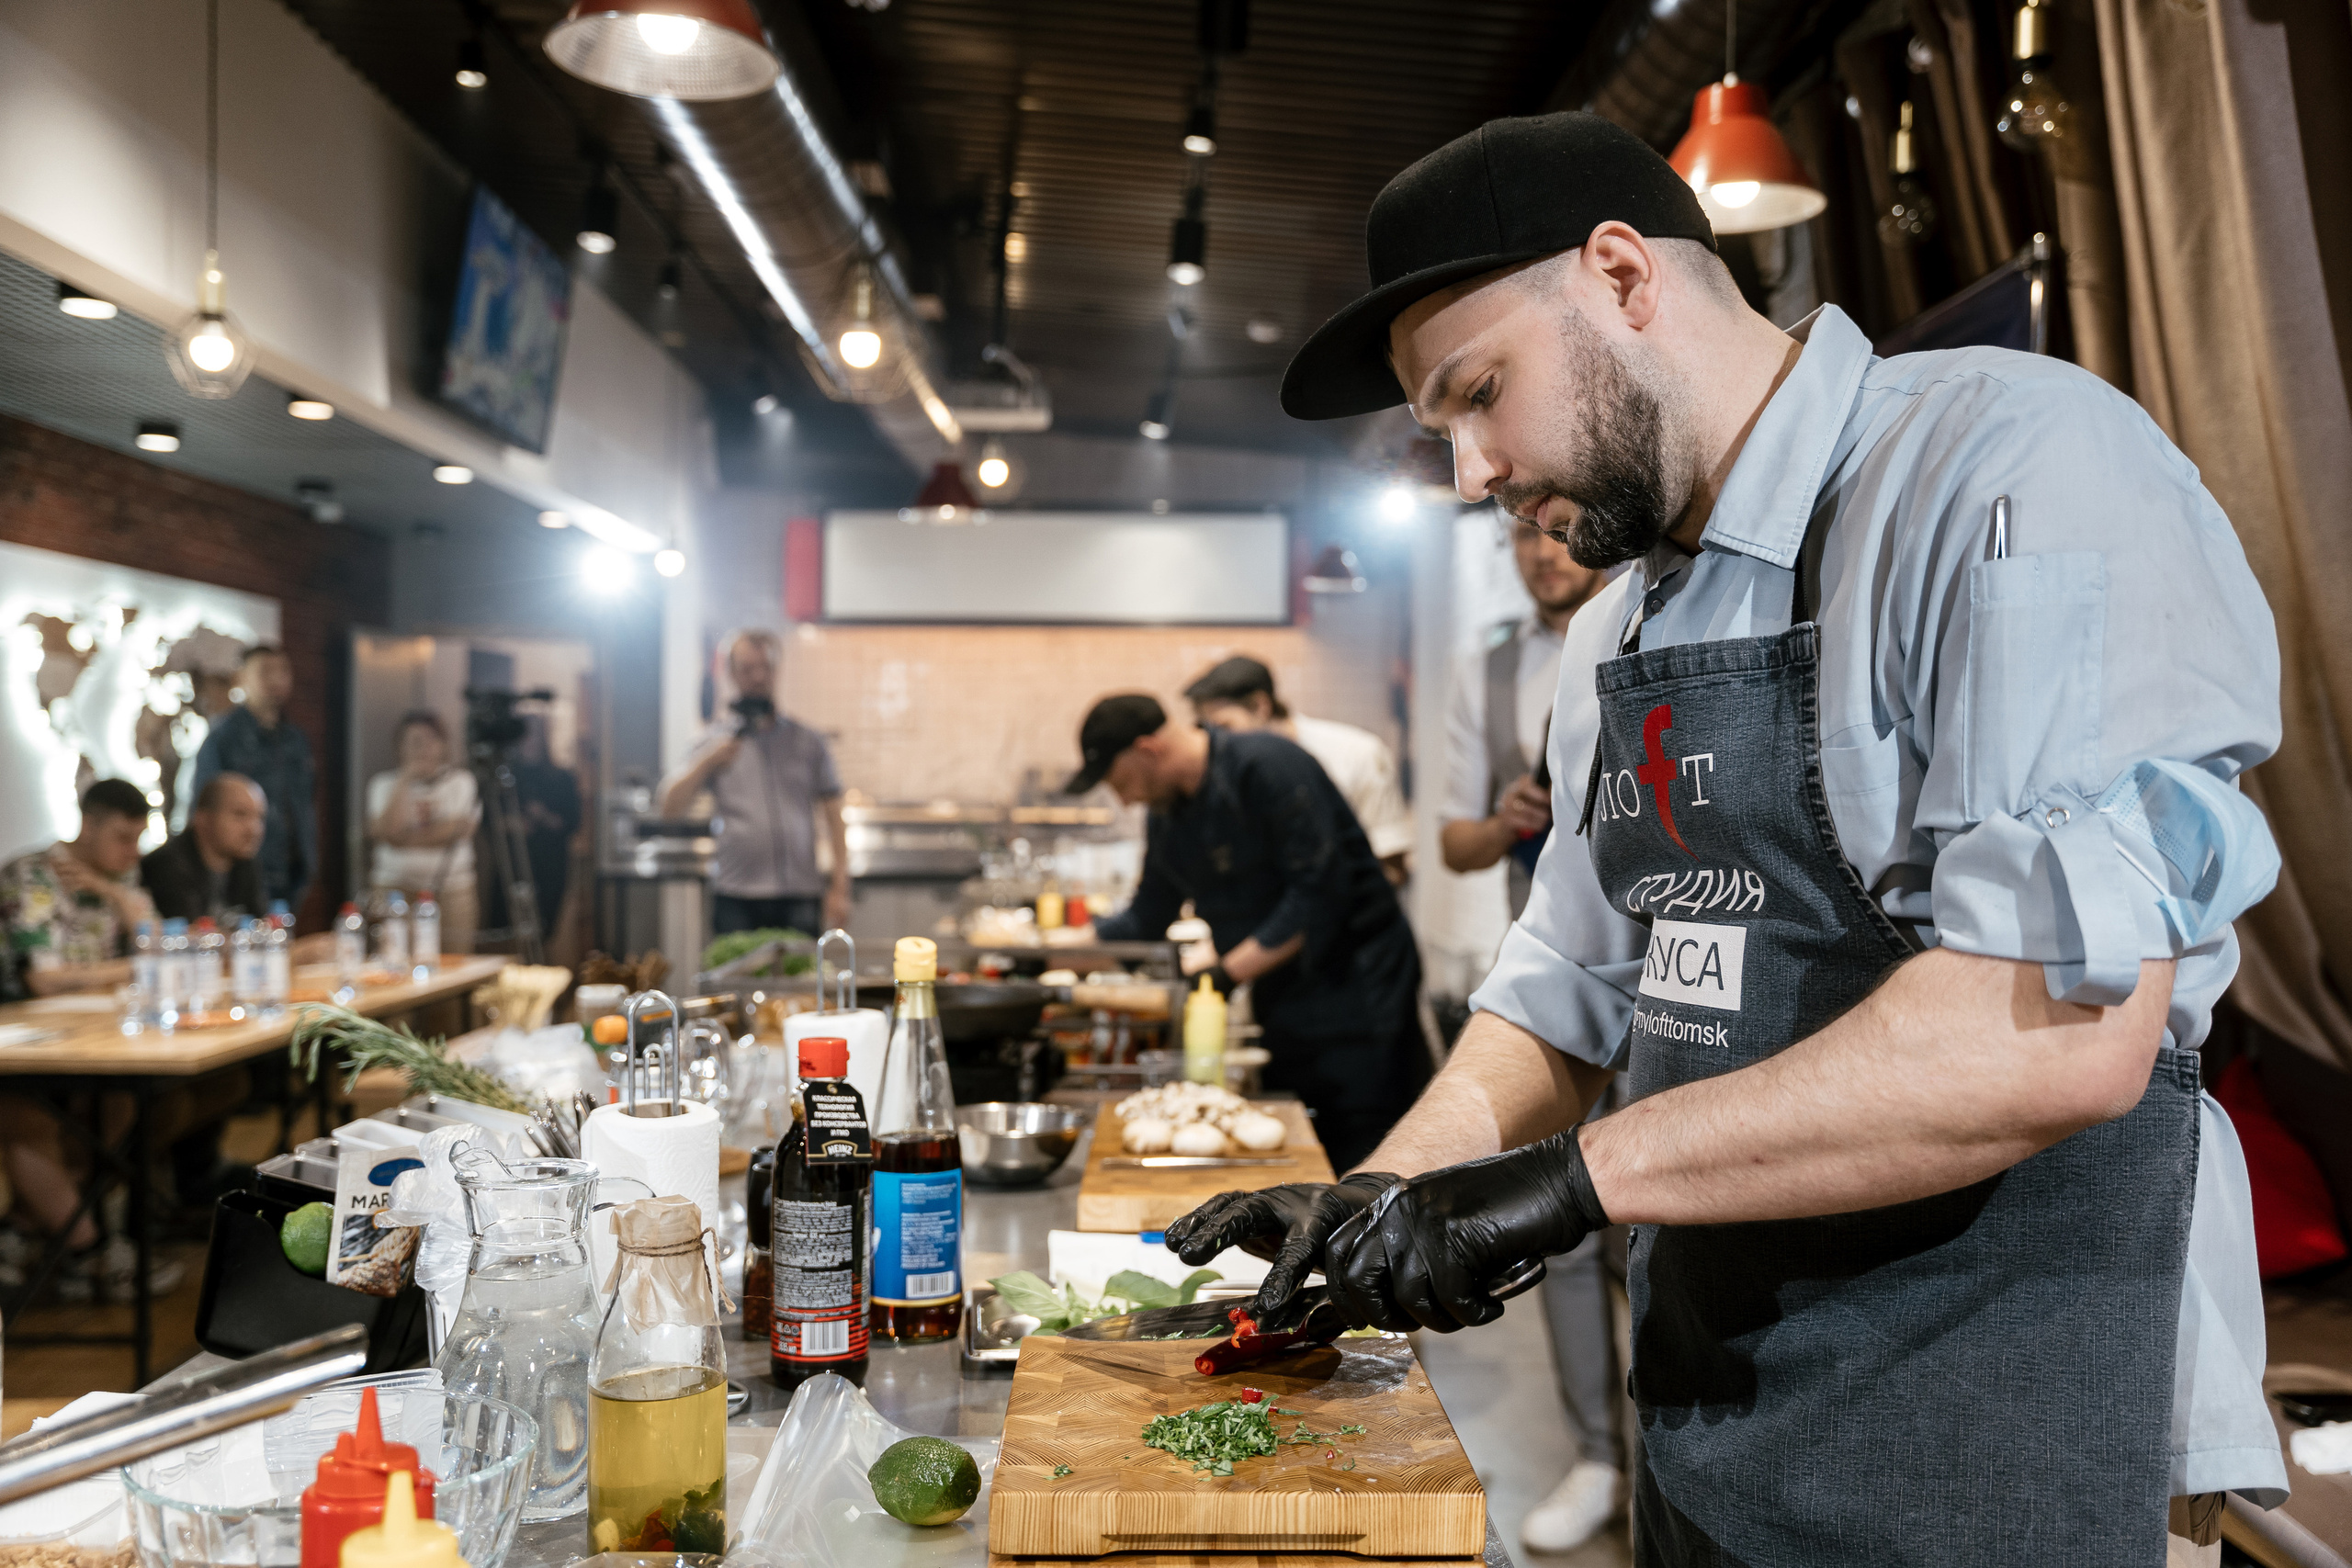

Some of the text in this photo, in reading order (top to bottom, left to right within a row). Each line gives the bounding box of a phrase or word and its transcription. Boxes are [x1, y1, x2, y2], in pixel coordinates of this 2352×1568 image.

[1627, 869, 1765, 915] СТУДИЯ
[1642, 932, 1724, 991] КУСА
[811, 1094, 857, 1103] КЛАССИЧЕСКАЯ
[816, 1102, 855, 1111] ТЕХНОЛОГИЯ
[813, 1111, 861, 1120] ПРОИЗВОДСТВА
[810, 1120, 867, 1129] БЕЗ КОНСЕРВАНТОВ
[836, 1129, 850, 1137] ГМО
[827, 1144, 853, 1156] HEINZ
